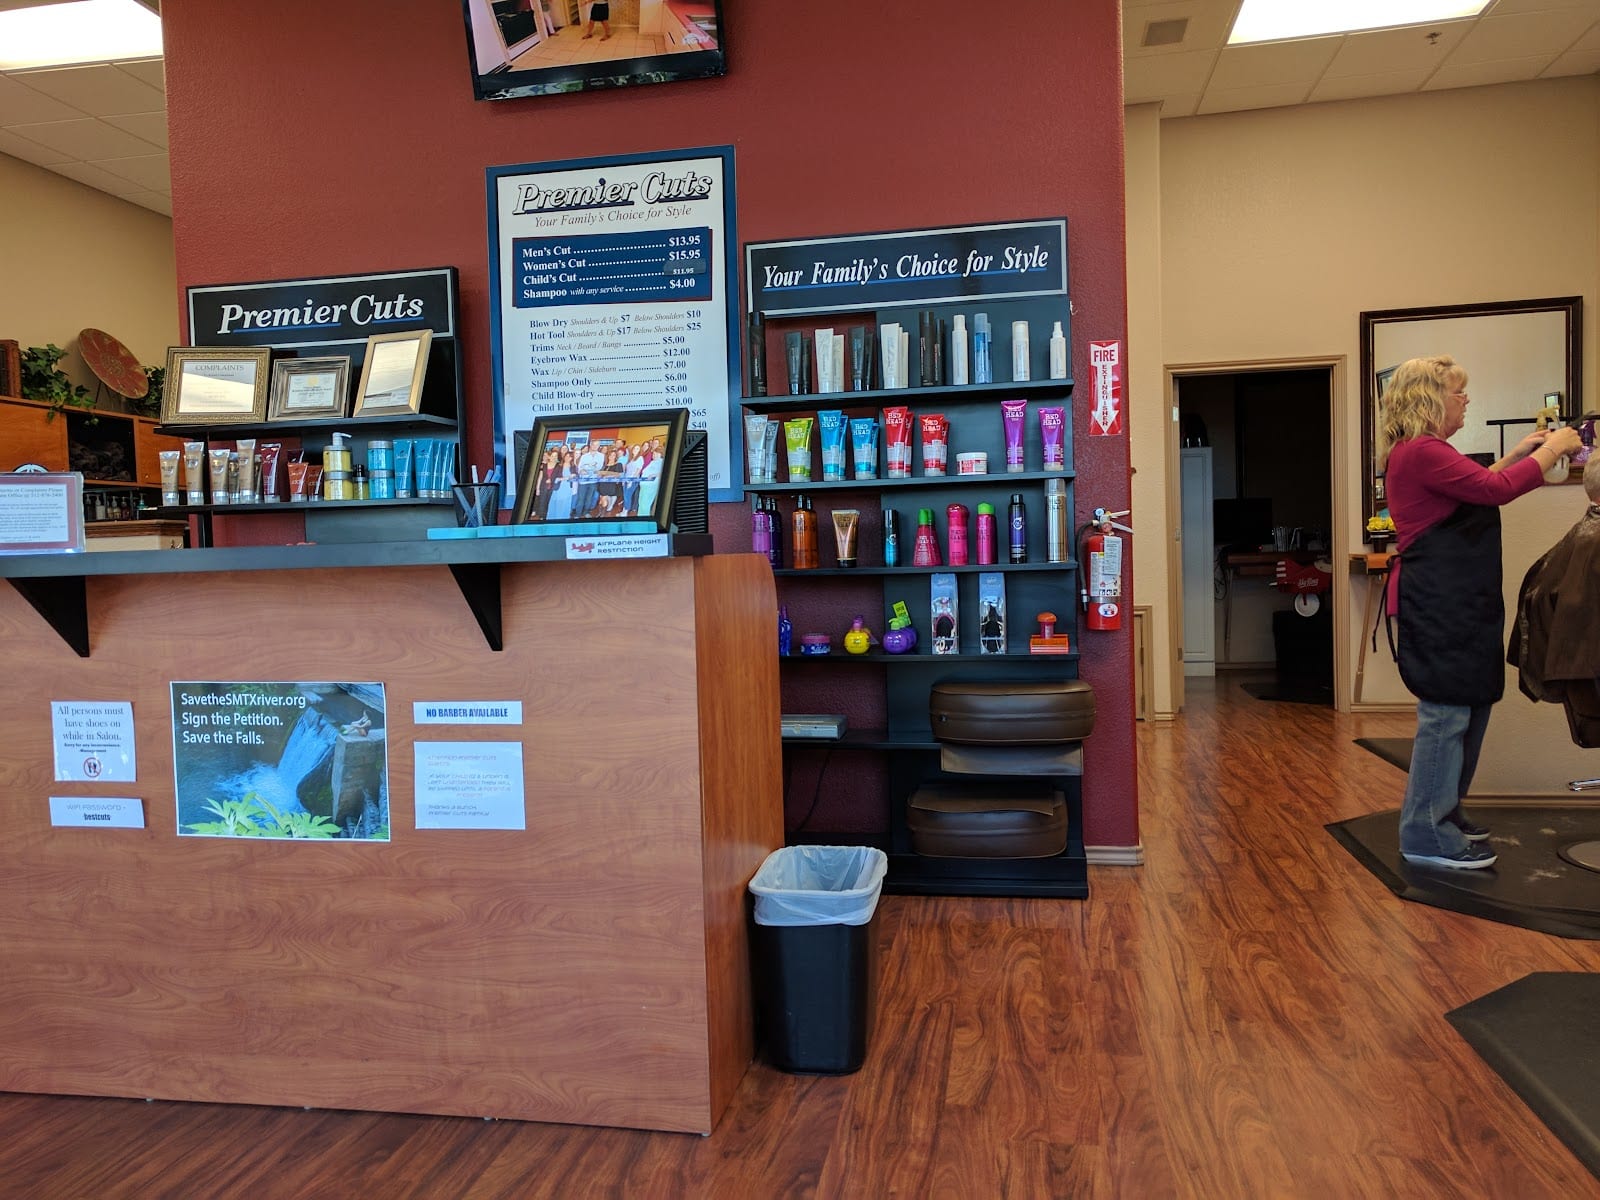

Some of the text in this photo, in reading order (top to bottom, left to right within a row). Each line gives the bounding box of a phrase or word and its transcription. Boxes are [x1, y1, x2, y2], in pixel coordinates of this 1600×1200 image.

[512, 171, 713, 215] Premier Cuts
[534, 205, 692, 228] Your Family's Choice for Style
[523, 235, 700, 258] Men's Cut $13.95
[523, 249, 700, 271] Women's Cut $15.95
[763, 245, 1049, 289] Your Family's Choice for Style
[523, 274, 557, 285] Child's
[559, 272, 577, 282] Cut
[524, 278, 695, 299] Shampoo with any service $4.00
[217, 294, 424, 334] Premier Cuts
[530, 320, 549, 328] Blow
[552, 318, 567, 329] Dry
[570, 317, 599, 326] Shoulders
[609, 316, 618, 325] Up
[620, 314, 630, 323] $7
[634, 314, 653, 322] Below
[655, 312, 684, 320] Shoulders
[686, 309, 701, 318] $10
[530, 331, 545, 340] Hot
[547, 330, 565, 339] Tool
[567, 329, 597, 338] Shoulders
[606, 328, 615, 338] Up
[617, 326, 631, 335] $17
[634, 326, 652, 334] Below
[654, 324, 684, 332] Shoulders
[686, 322, 702, 331] $25
[530, 344, 554, 352] Trims
[577, 342, 597, 350] Beard
[602, 341, 621, 350] Bangs
[662, 336, 685, 345] $5.00
[531, 348, 690, 365] Eyebrow Wax $12.00
[1094, 350, 1115, 362] FIRE
[551, 367, 563, 376] Lip
[567, 366, 583, 374] Chin
[588, 364, 616, 374] Sideburn
[664, 360, 686, 370] $7.00
[532, 372, 687, 389] Shampoo Only $6.00
[532, 385, 687, 400] Child Blow-dry $5.00
[532, 397, 693, 412] Child Hot Tool $10.00
[692, 409, 706, 417] $65
[692, 421, 706, 429] $40
[181, 693, 306, 708] SavetheSMTXriver.org
[58, 706, 123, 716] All persons must
[426, 708, 508, 717] NO BARBER AVAILABLE
[65, 719, 120, 728] have shoes on
[182, 712, 283, 728] Sign the Petition.
[63, 732, 121, 740] while in Salon.
[183, 731, 264, 745] Save the Falls.
